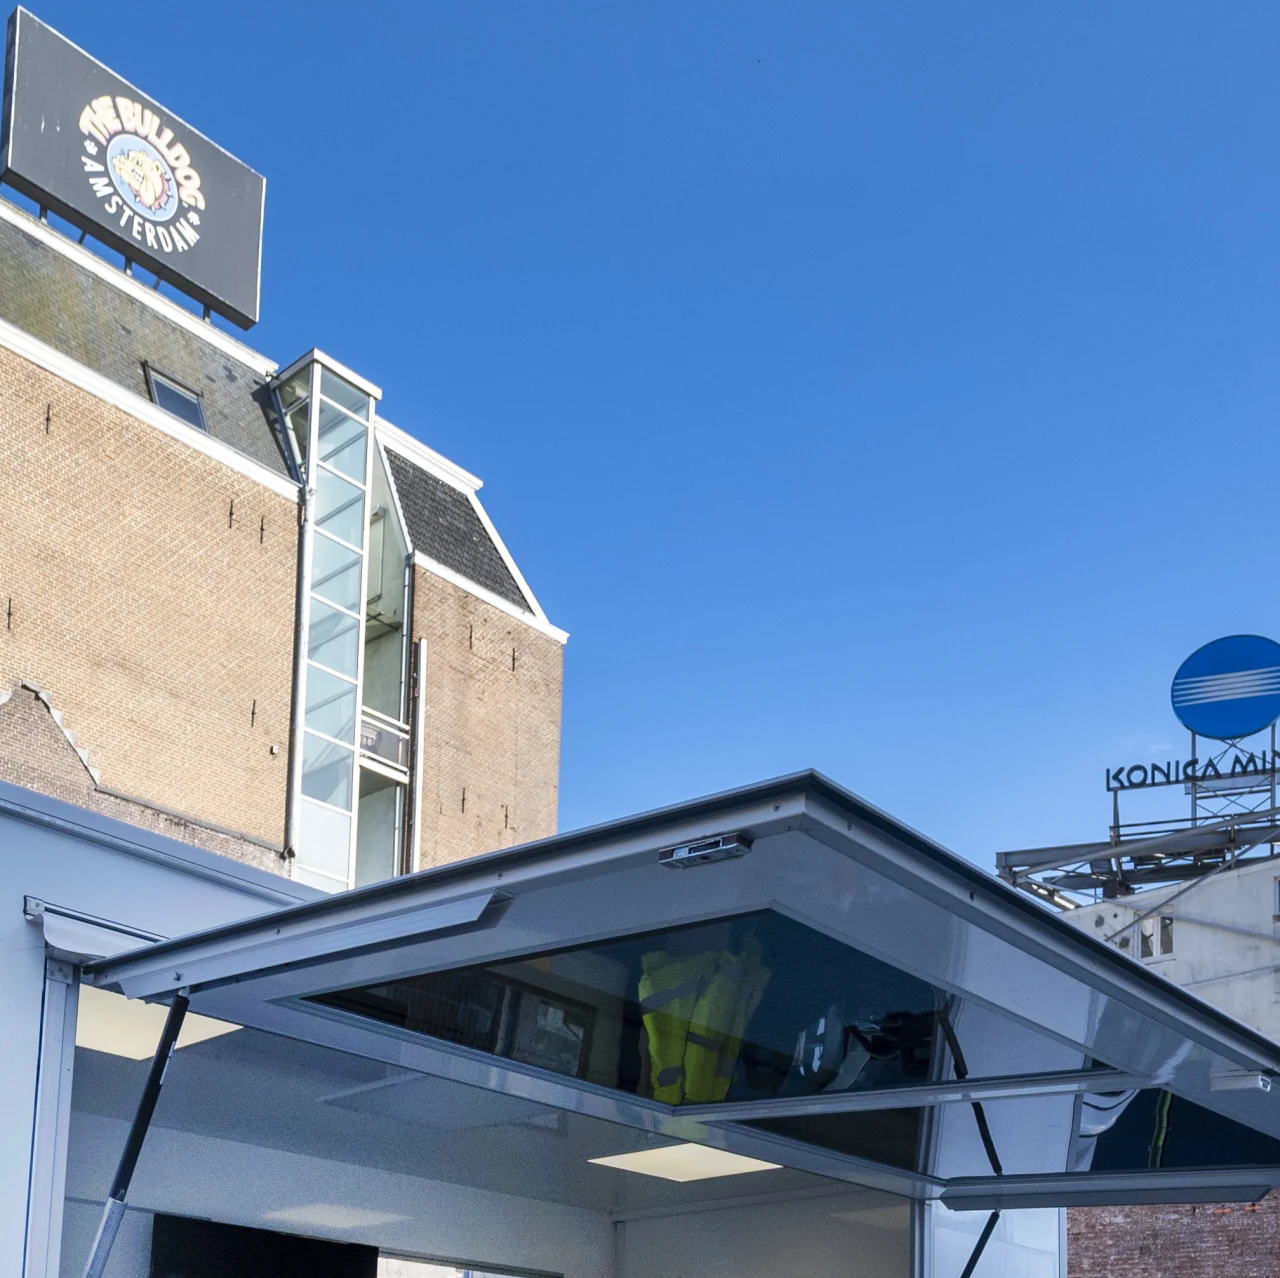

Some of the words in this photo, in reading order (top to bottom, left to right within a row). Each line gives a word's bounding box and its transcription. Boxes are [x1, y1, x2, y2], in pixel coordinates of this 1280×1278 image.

[79, 96, 121, 146] THE
[115, 96, 205, 211] BULLDOG
[81, 156, 200, 252] AMSTERDAM
[1106, 757, 1222, 791] KONICA
